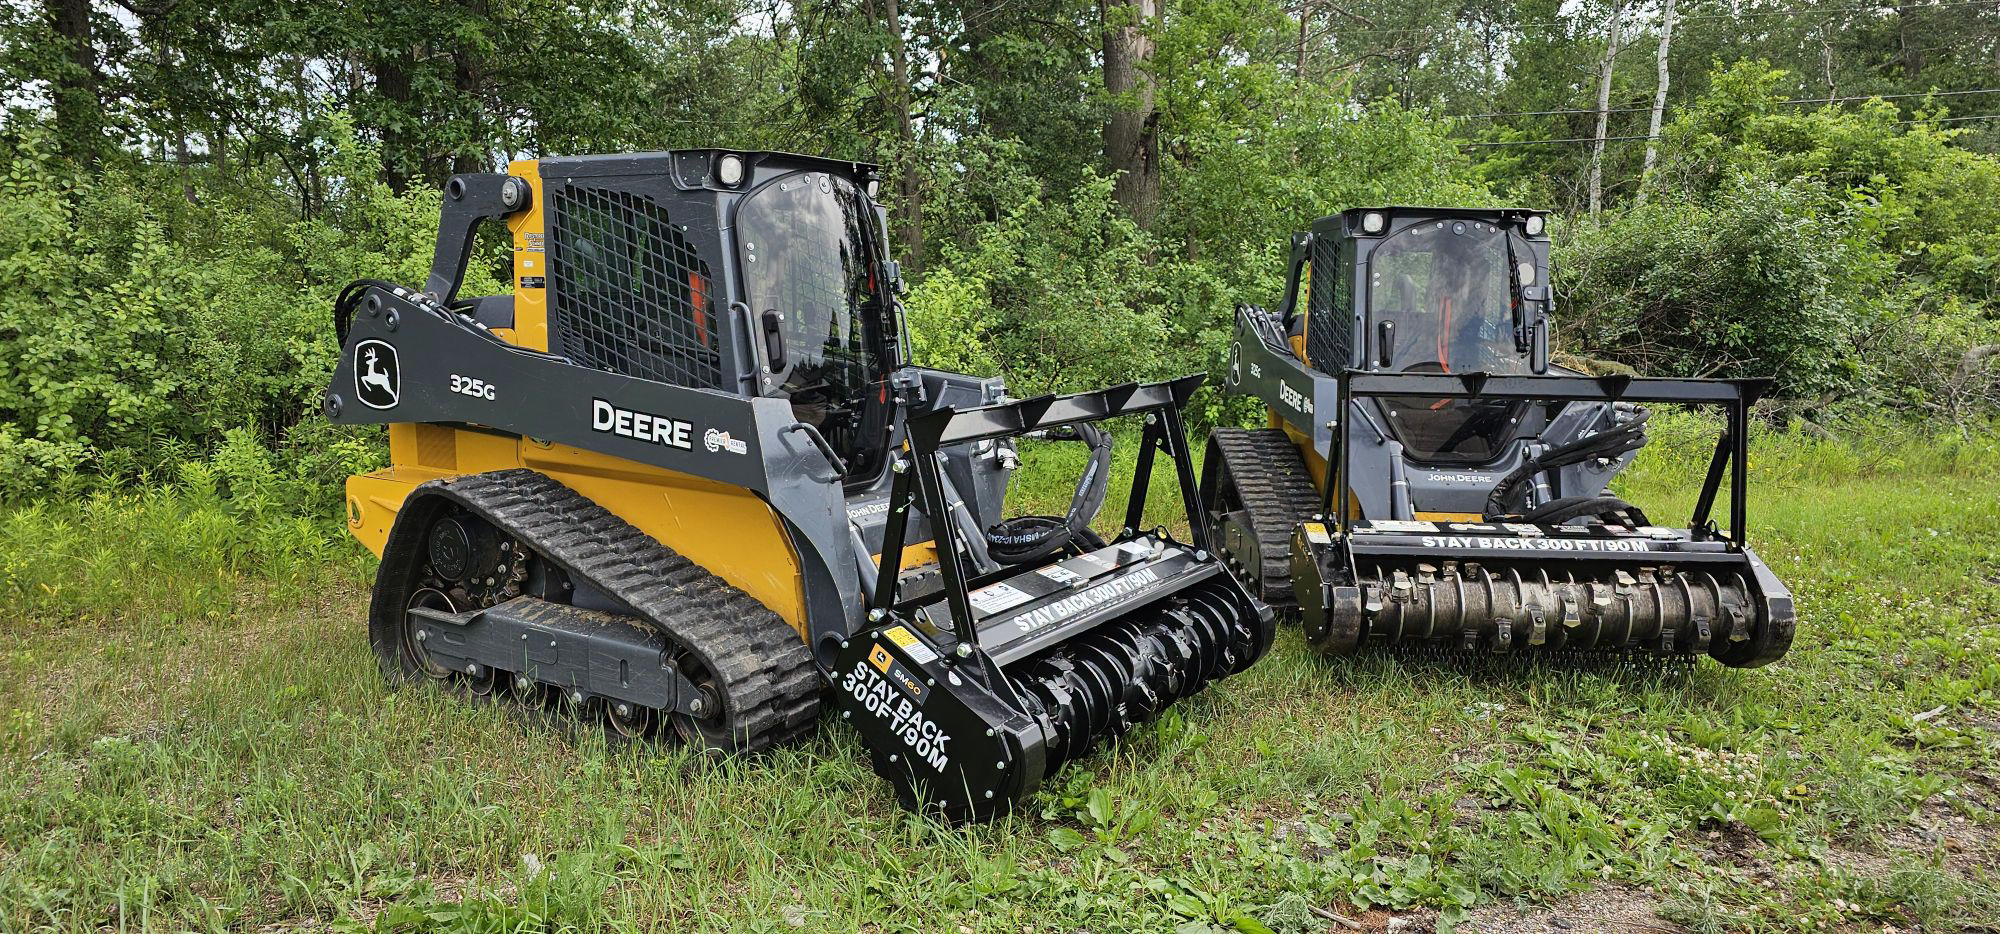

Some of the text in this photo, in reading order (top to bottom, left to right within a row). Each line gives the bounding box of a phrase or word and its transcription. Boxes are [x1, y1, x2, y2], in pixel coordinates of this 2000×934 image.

[450, 374, 495, 401] 325G
[1280, 379, 1302, 412] DEERE
[593, 399, 692, 449] DEERE
[1428, 474, 1492, 483] JOHN DEERE
[1014, 532, 1039, 543] MSHA
[1422, 536, 1472, 548] STAY
[1478, 538, 1535, 550] BACK
[1537, 539, 1573, 550] 300
[1014, 605, 1055, 632] STAY
[1054, 591, 1092, 617] BACK
[1089, 584, 1115, 603] 300
[1111, 567, 1159, 594] FT/90M
[894, 669, 921, 696] SM60
[854, 661, 951, 753] STAY BACK
[843, 673, 949, 773] 300FT/90M
